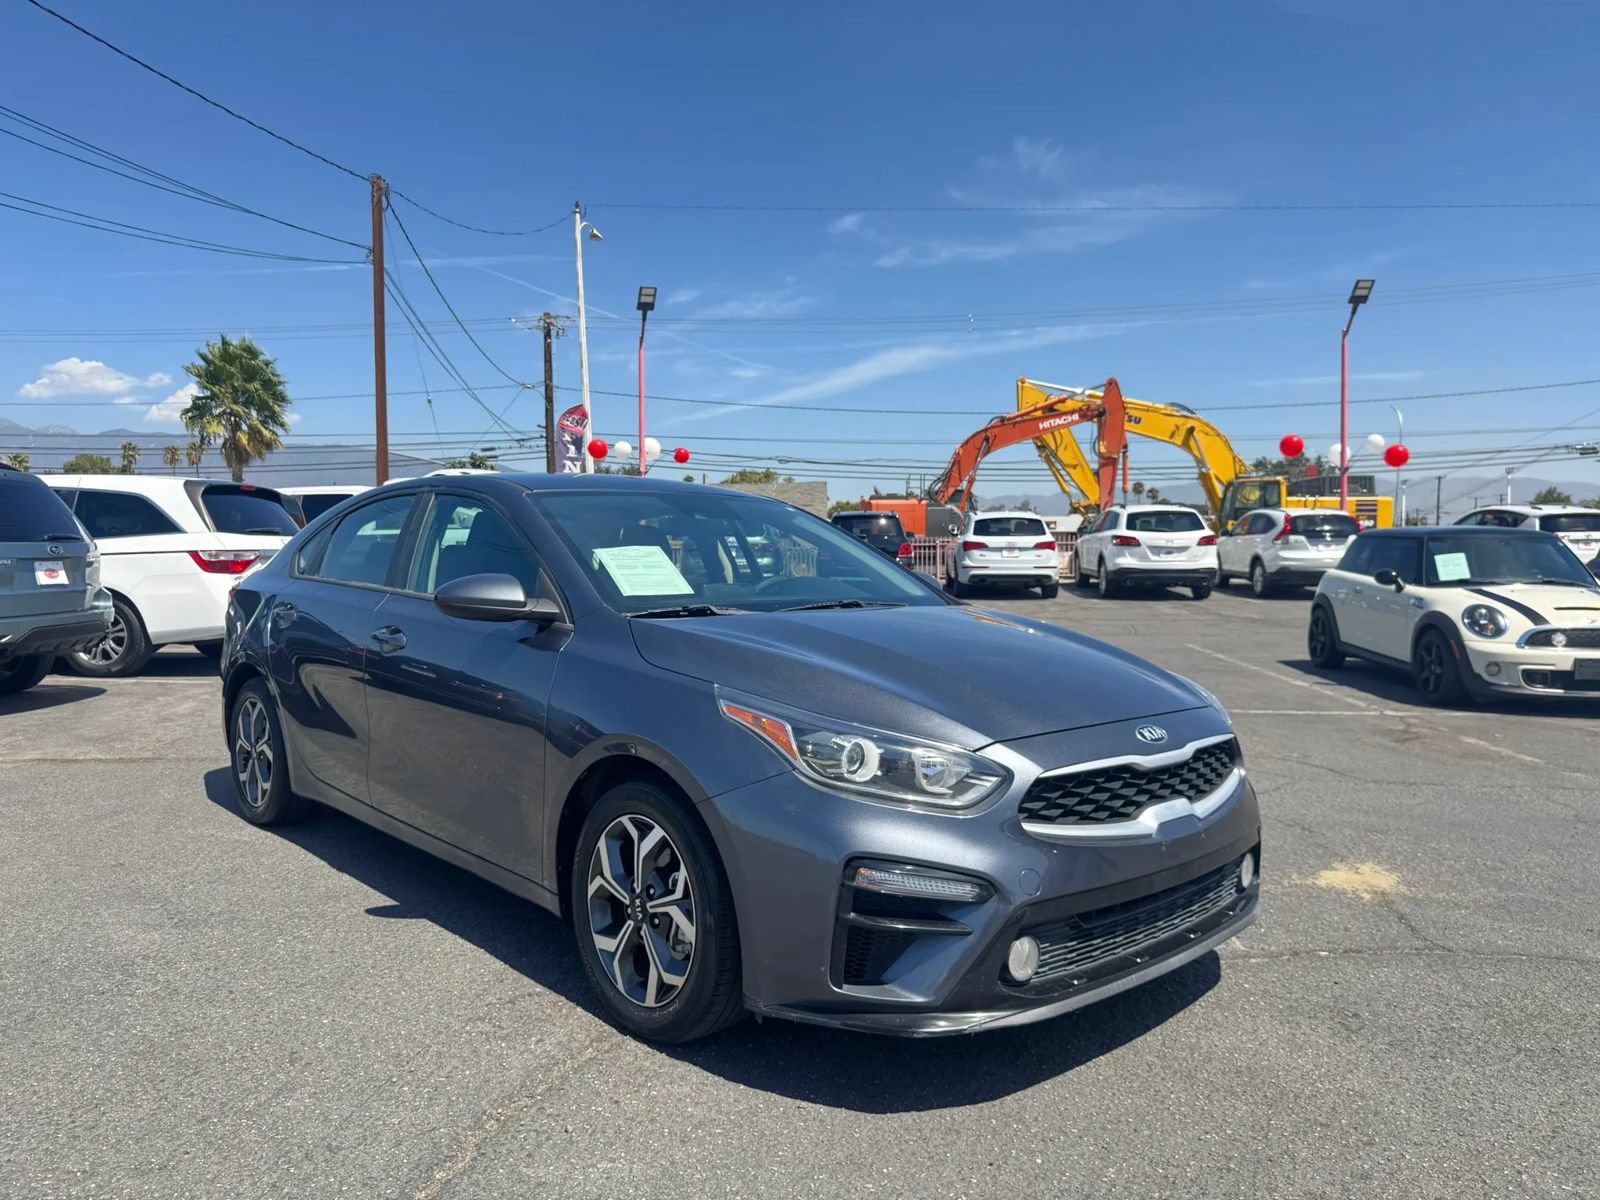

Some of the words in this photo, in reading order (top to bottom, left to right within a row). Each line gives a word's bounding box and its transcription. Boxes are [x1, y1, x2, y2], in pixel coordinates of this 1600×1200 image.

[1038, 412, 1080, 430] HITACHI
[1126, 412, 1142, 425] SU
[1139, 725, 1167, 741] KIA
[634, 898, 643, 920] KIA
